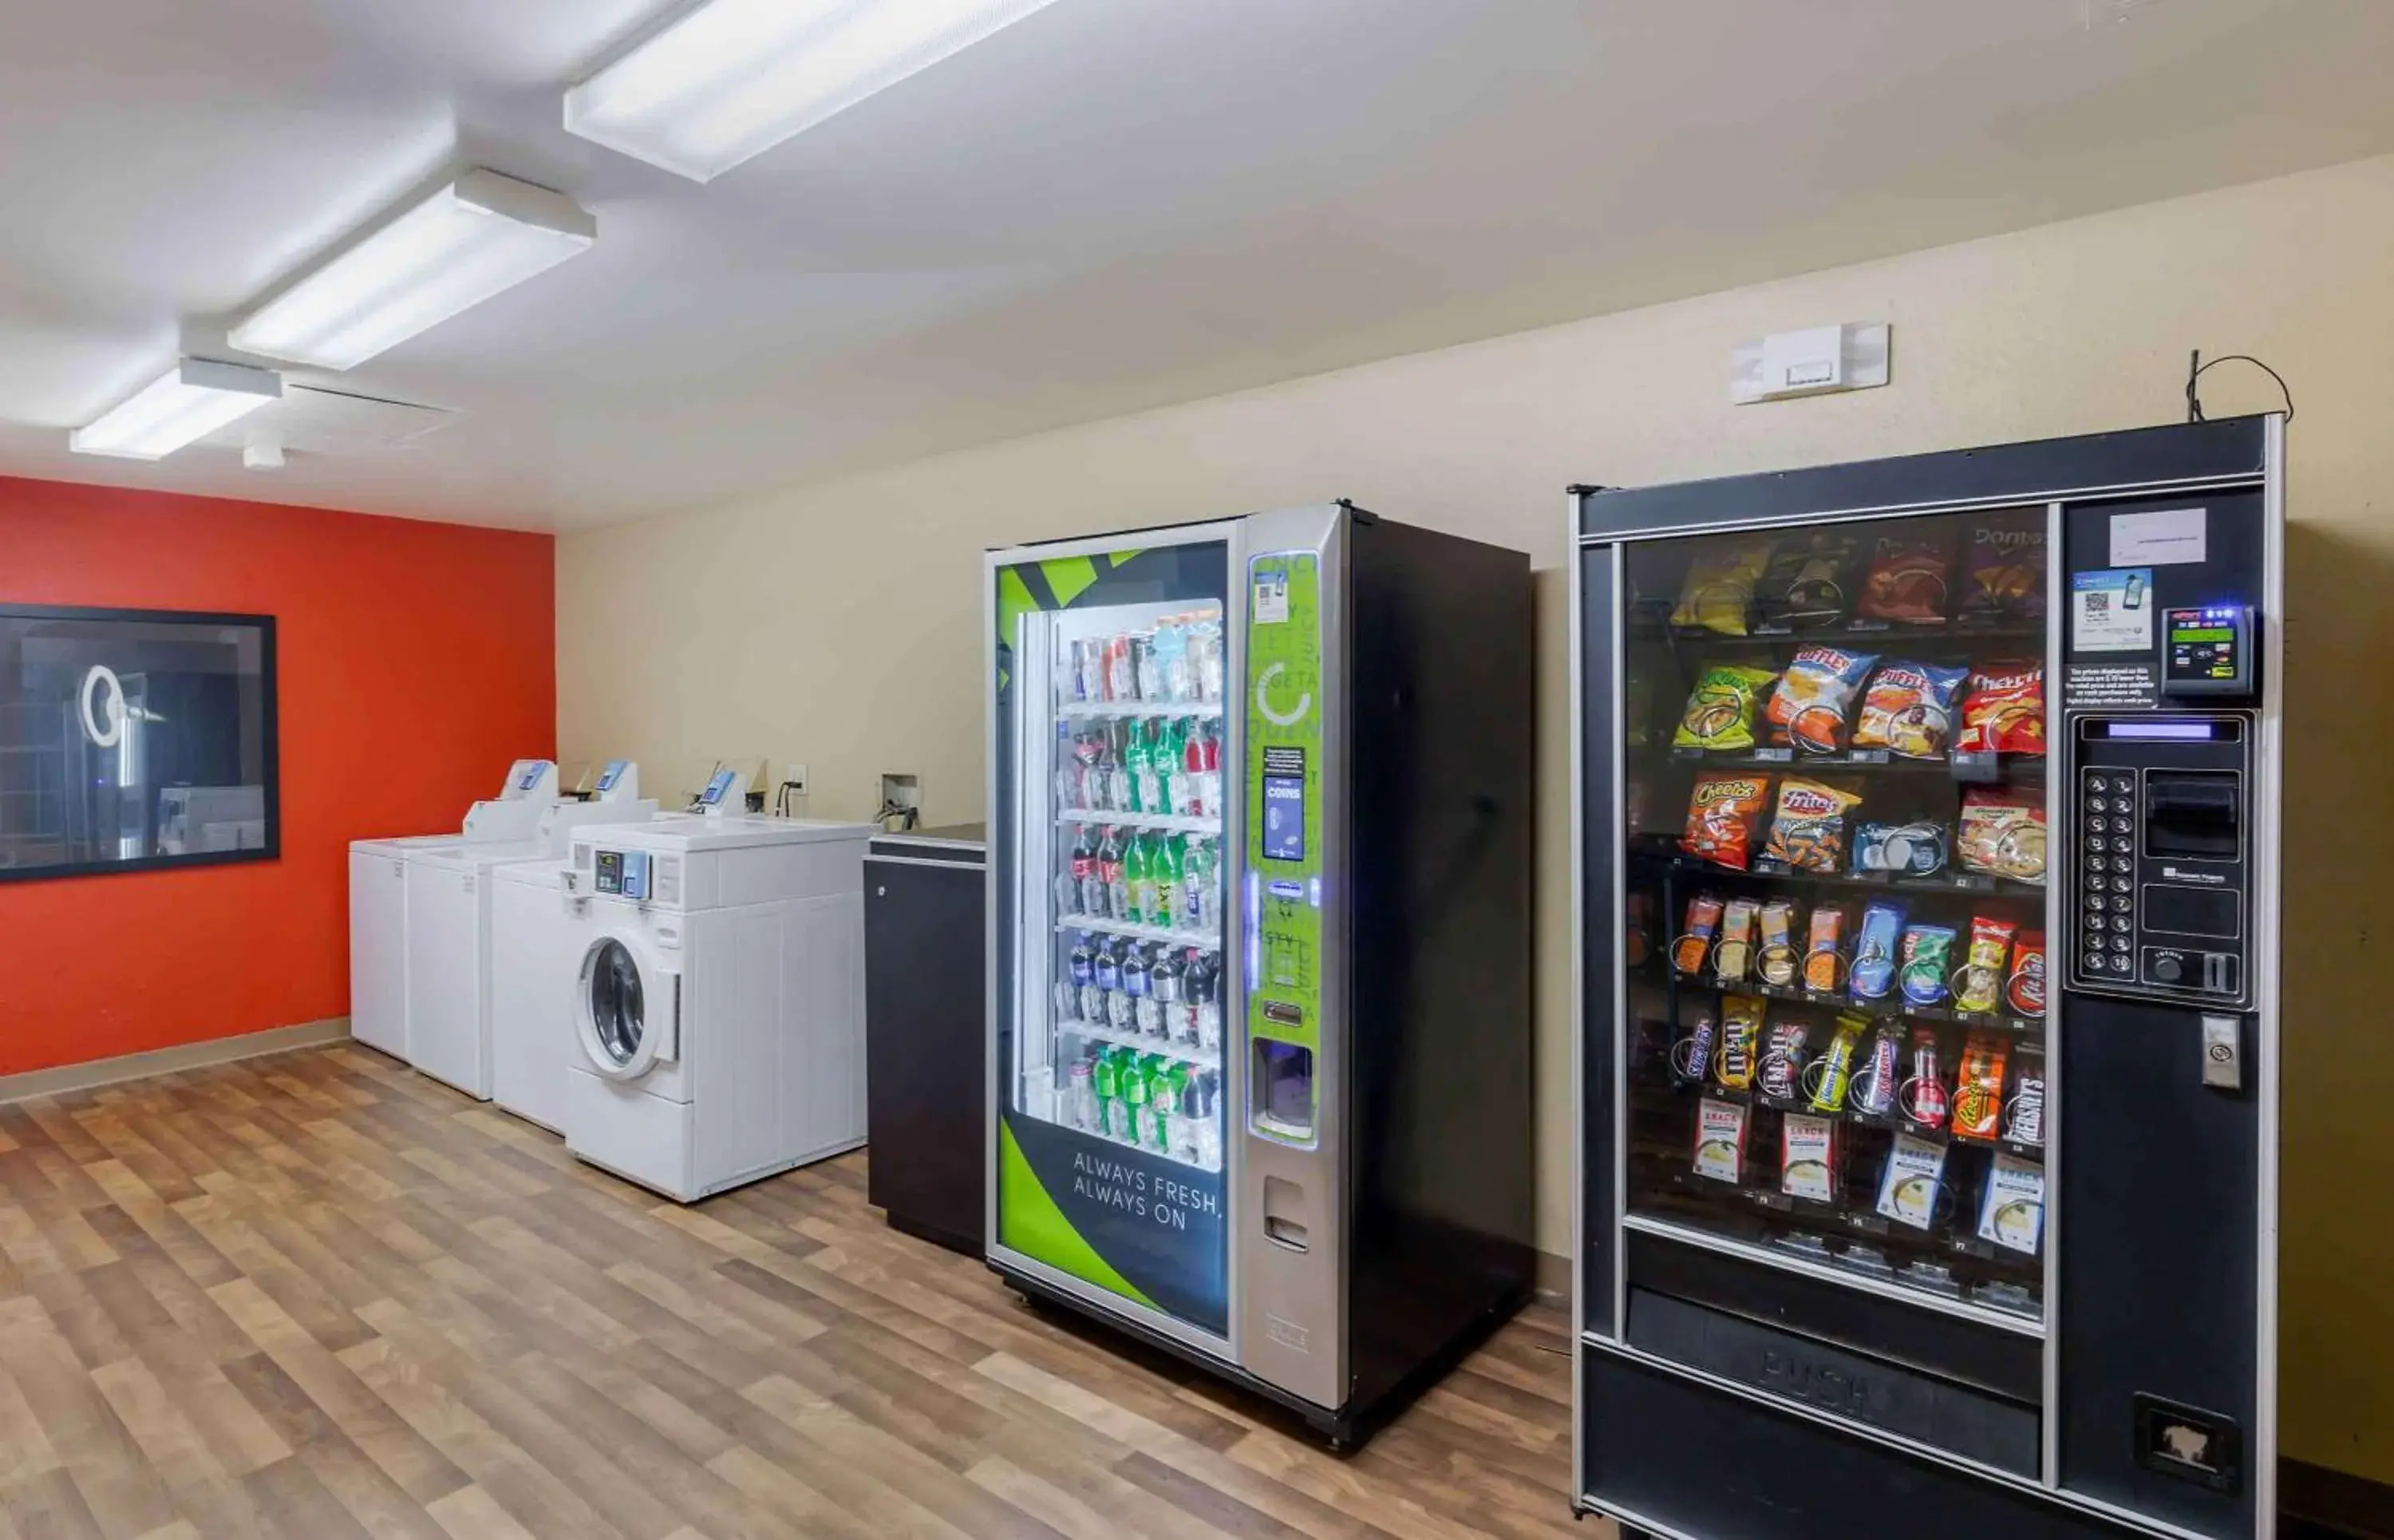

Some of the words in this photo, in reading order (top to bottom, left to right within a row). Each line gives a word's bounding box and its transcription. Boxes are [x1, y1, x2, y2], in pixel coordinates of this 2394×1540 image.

[1695, 780, 1756, 807] Cheetos
[1074, 1152, 1146, 1191] ALWAYS
[1074, 1177, 1146, 1216] ALWAYS
[1155, 1203, 1187, 1231] ON
